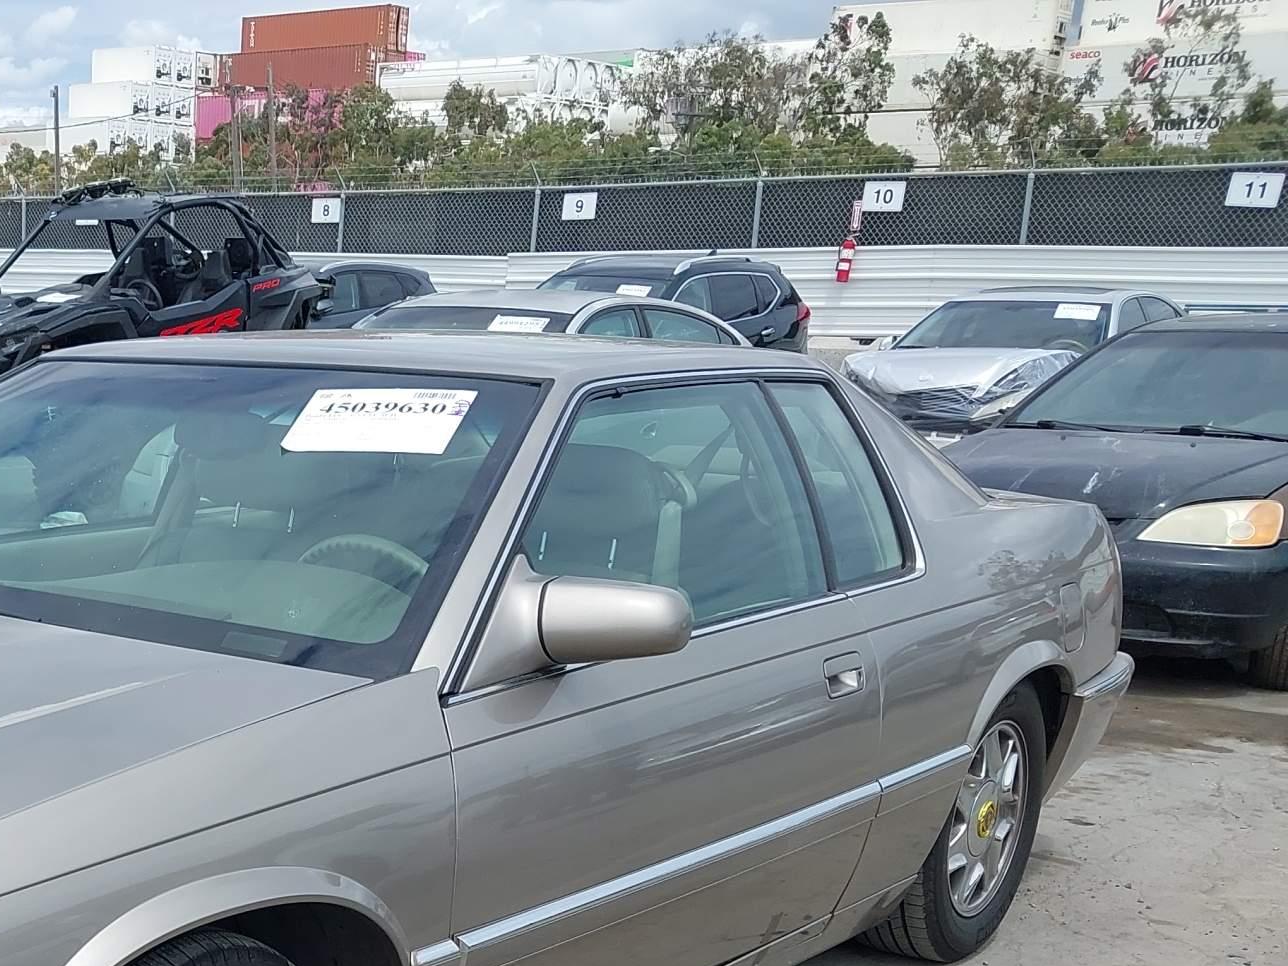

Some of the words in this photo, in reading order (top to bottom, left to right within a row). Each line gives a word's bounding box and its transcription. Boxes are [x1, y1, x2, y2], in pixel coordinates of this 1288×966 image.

[1070, 50, 1101, 59] seaco
[1163, 50, 1247, 68] HORIZON
[874, 188, 893, 204] 10
[1245, 181, 1268, 198] 11
[322, 204, 330, 217] 8
[575, 199, 584, 213] 9
[252, 279, 280, 292] PRO
[319, 402, 447, 414] 45039630
